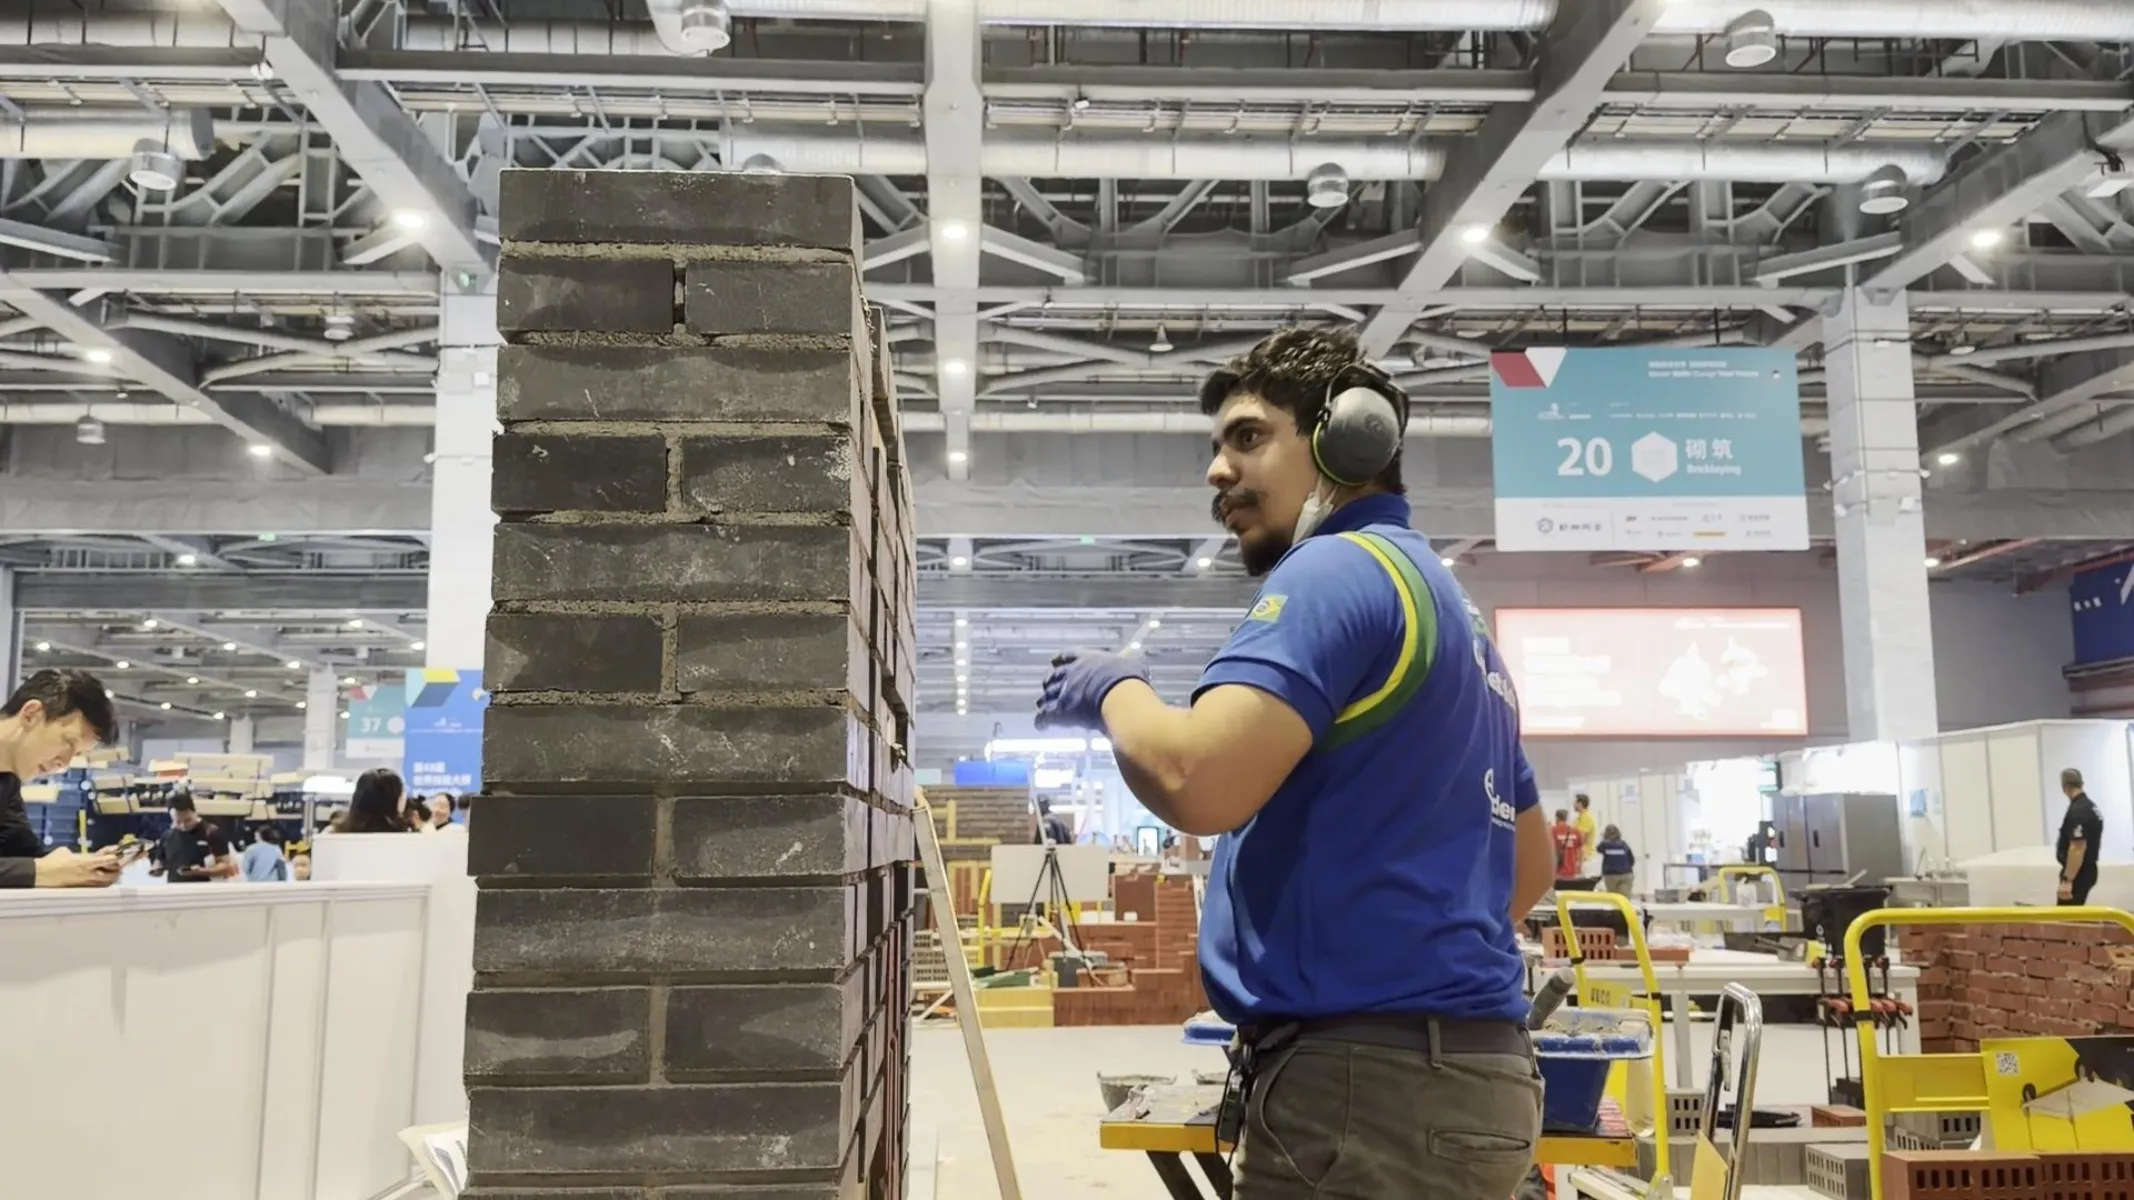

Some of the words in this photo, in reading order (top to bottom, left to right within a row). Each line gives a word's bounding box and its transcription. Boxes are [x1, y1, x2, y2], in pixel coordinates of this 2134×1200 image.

[1557, 437, 1612, 477] 20
[1685, 438, 1734, 461] 砌筑
[1686, 463, 1742, 477] Bricklaying
[360, 717, 382, 733] 37
